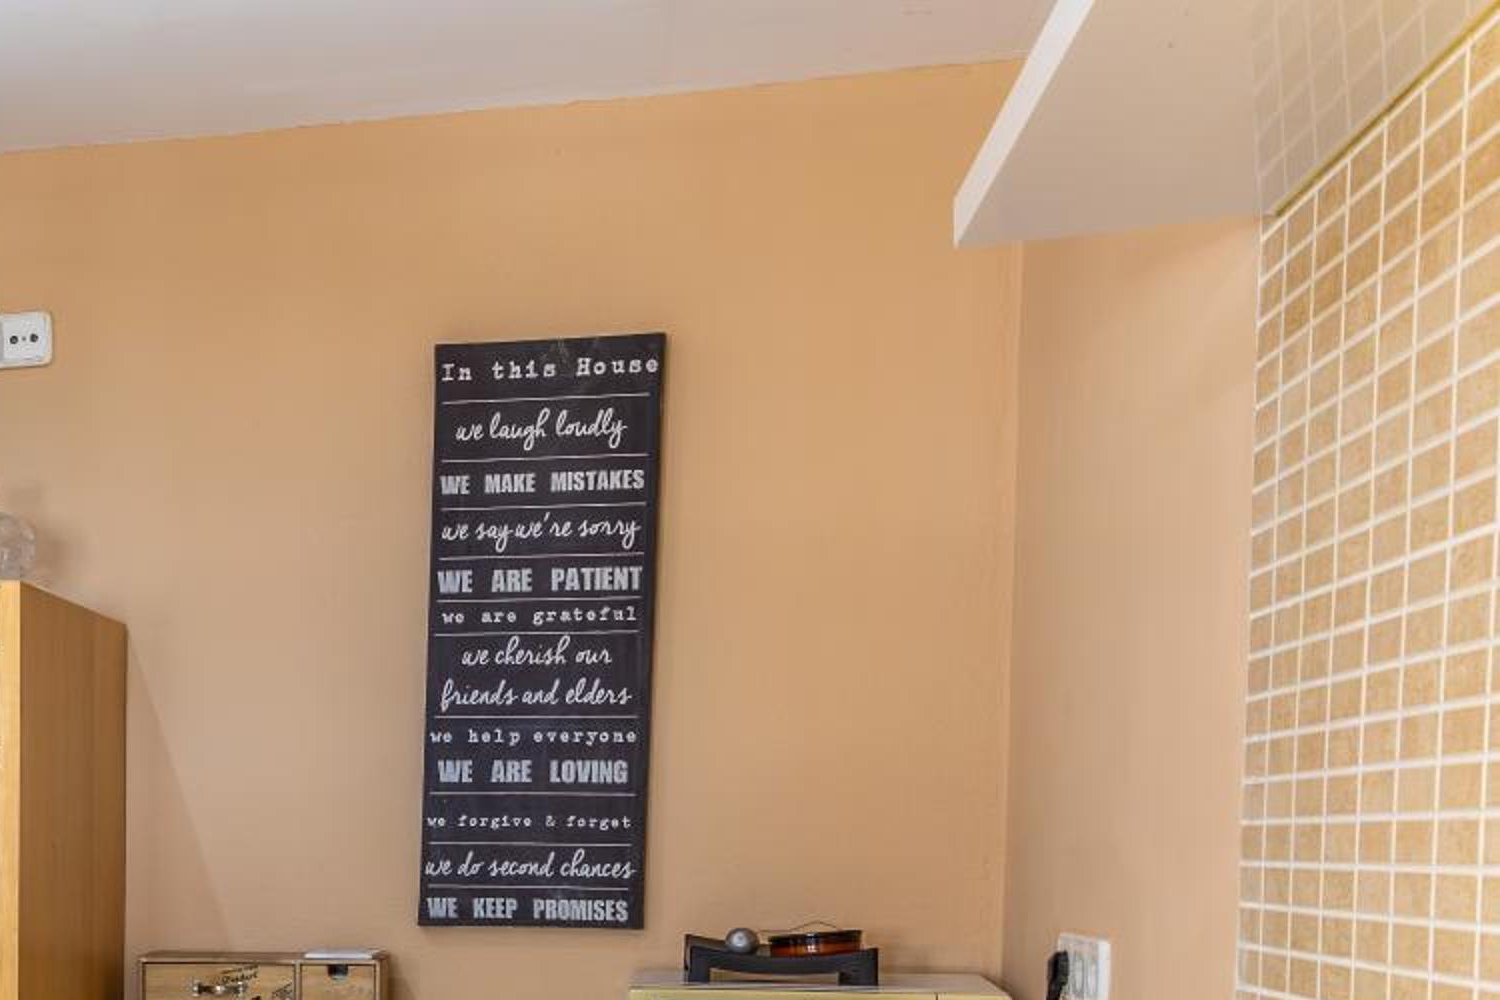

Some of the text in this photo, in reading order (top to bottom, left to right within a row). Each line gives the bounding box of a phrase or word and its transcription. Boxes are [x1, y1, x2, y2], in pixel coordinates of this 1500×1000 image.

[442, 357, 659, 381] In this House
[456, 408, 628, 451] we laugh loudly
[439, 470, 645, 495] WE MAKE MISTAKES
[442, 512, 641, 552] we say we're sorry
[437, 566, 643, 594] WE ARE PATIENT
[442, 606, 637, 625] we are grateful
[461, 635, 613, 665] we cherish our
[440, 677, 633, 713] friends and elders
[430, 729, 637, 746] we help everyone
[438, 760, 629, 784] WE ARE LOVING
[427, 816, 632, 831] we forgive & forget
[425, 848, 636, 879] we do second chances
[426, 897, 629, 922] WE KEEP PROMISES
